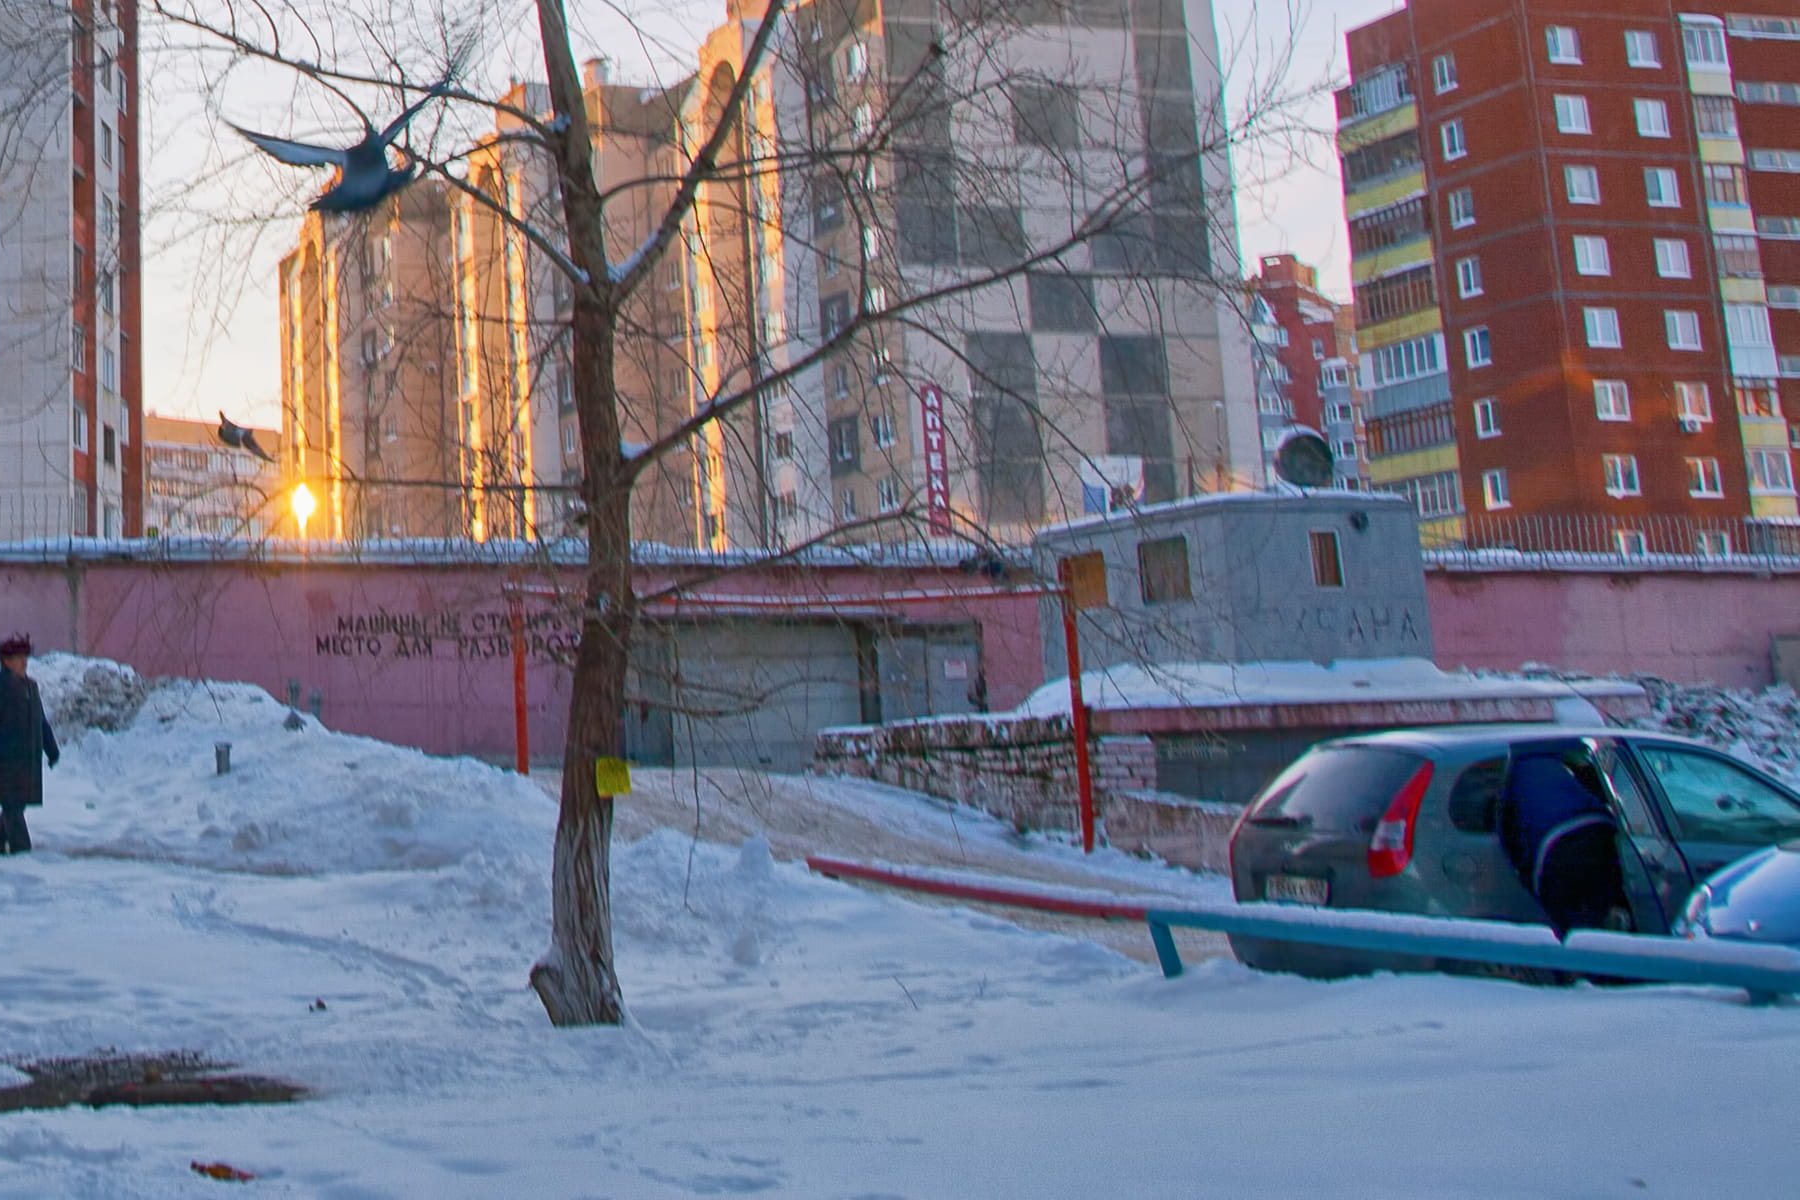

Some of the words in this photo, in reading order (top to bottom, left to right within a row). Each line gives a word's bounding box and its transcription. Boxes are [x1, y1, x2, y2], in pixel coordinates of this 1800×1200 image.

[925, 389, 947, 510] АПТЕКА
[315, 635, 382, 656] МЕСТО
[394, 636, 433, 659] ДЛЯ
